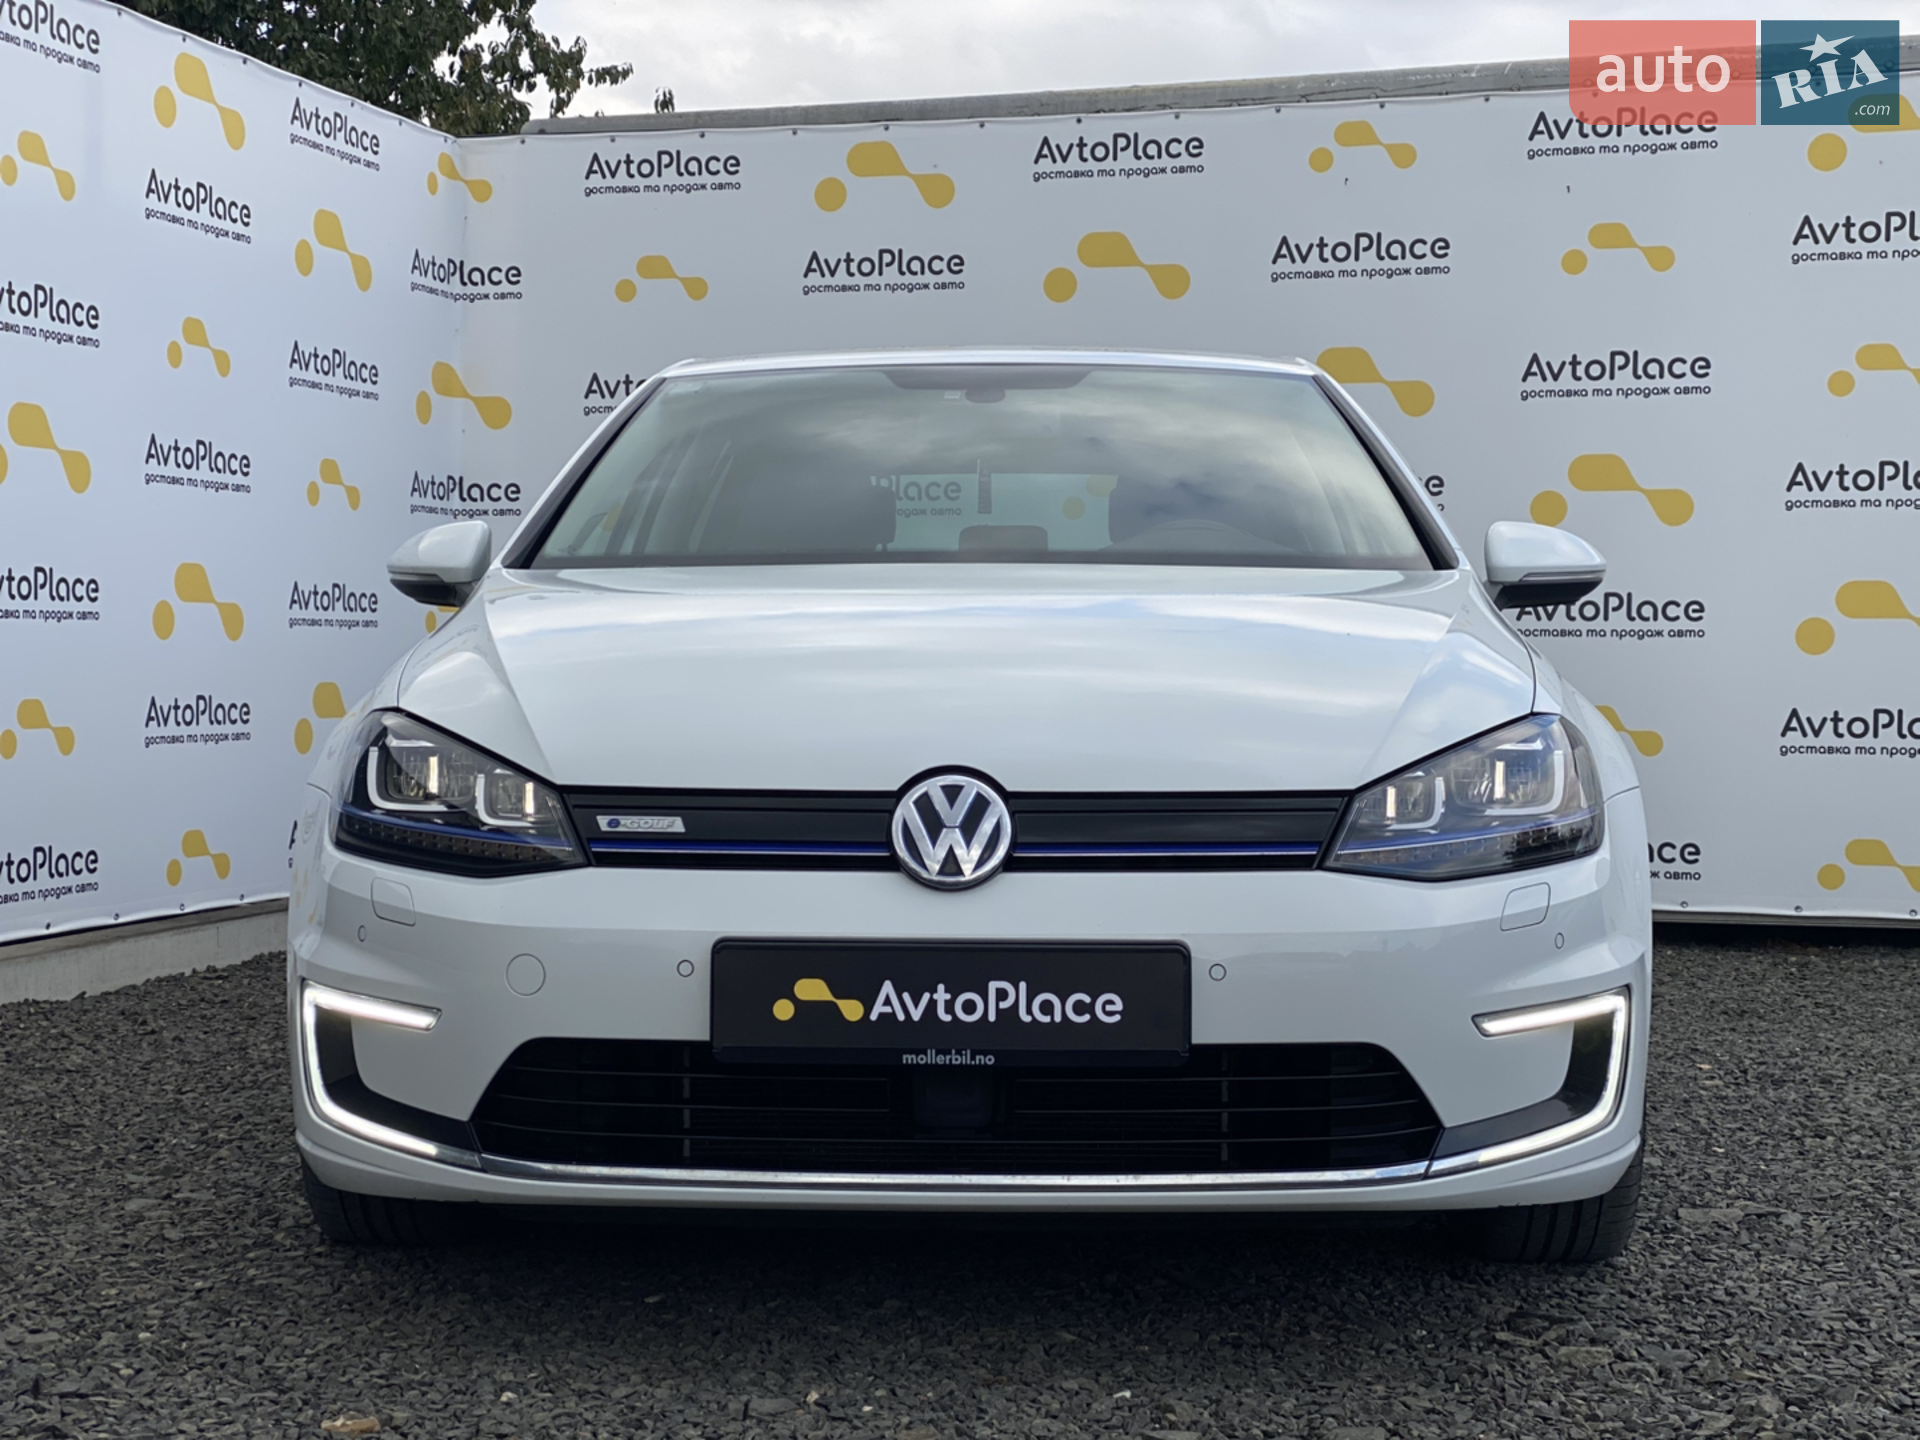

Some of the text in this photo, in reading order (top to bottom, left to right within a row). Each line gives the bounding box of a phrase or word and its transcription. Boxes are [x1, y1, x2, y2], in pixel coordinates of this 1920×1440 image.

[23, 39, 37, 52] та
[40, 44, 75, 65] продаж
[76, 57, 101, 74] авто
[290, 97, 380, 156] AvtoPlace
[1527, 106, 1718, 142] AvtoPlace
[290, 132, 381, 172] доставка та продаж авто
[1033, 131, 1205, 166] AvtoPlace
[1526, 139, 1719, 161] доставка та продаж авто
[584, 149, 741, 180] AvtoPlace
[1032, 164, 1205, 183] доставка та продаж авто
[145, 168, 252, 228] AvtoPlace
[584, 181, 742, 198] доставка та продаж авто
[145, 207, 252, 245] доставка та продаж авто
[1271, 231, 1451, 266] AvtoPlace
[1790, 250, 1863, 265] доставка
[1866, 250, 1889, 260] та
[411, 247, 522, 288] AvtoPlace
[803, 248, 965, 279] AvtoPlace
[1270, 265, 1451, 284] доставка та продаж авто
[802, 280, 966, 297] доставка та продаж авто
[23, 325, 37, 338] та
[39, 328, 74, 345] продаж
[76, 335, 101, 349] авто
[289, 340, 379, 386] AvtoPlace
[1520, 349, 1712, 384] AvtoPlace
[289, 376, 379, 402] доставка та продаж авто
[1519, 385, 1712, 402] доставка та продаж авто
[145, 433, 251, 478] AvtoPlace
[145, 473, 252, 494] доставка та продаж авто
[411, 470, 522, 503] AvtoPlace
[1784, 499, 1857, 512] доставка
[1859, 498, 1883, 508] та
[289, 580, 378, 614] AvtoPlace
[23, 609, 37, 620] та
[39, 609, 74, 624] продаж
[76, 610, 101, 621] авто
[289, 617, 379, 631] доставка та продаж авто
[1585, 628, 1608, 638] та
[1610, 628, 1665, 641] продаж
[1667, 628, 1706, 639] авто
[145, 694, 251, 729] AvtoPlace
[145, 731, 252, 748] доставка та продаж авто
[1779, 744, 1852, 757] доставка
[1854, 745, 1877, 756] та
[1663, 870, 1702, 881] авто
[22, 889, 36, 901] та
[38, 885, 73, 902] продаж
[75, 881, 99, 894] авто
[869, 979, 1124, 1024] AvtoPlace
[902, 1050, 996, 1066] mollerbil.no
